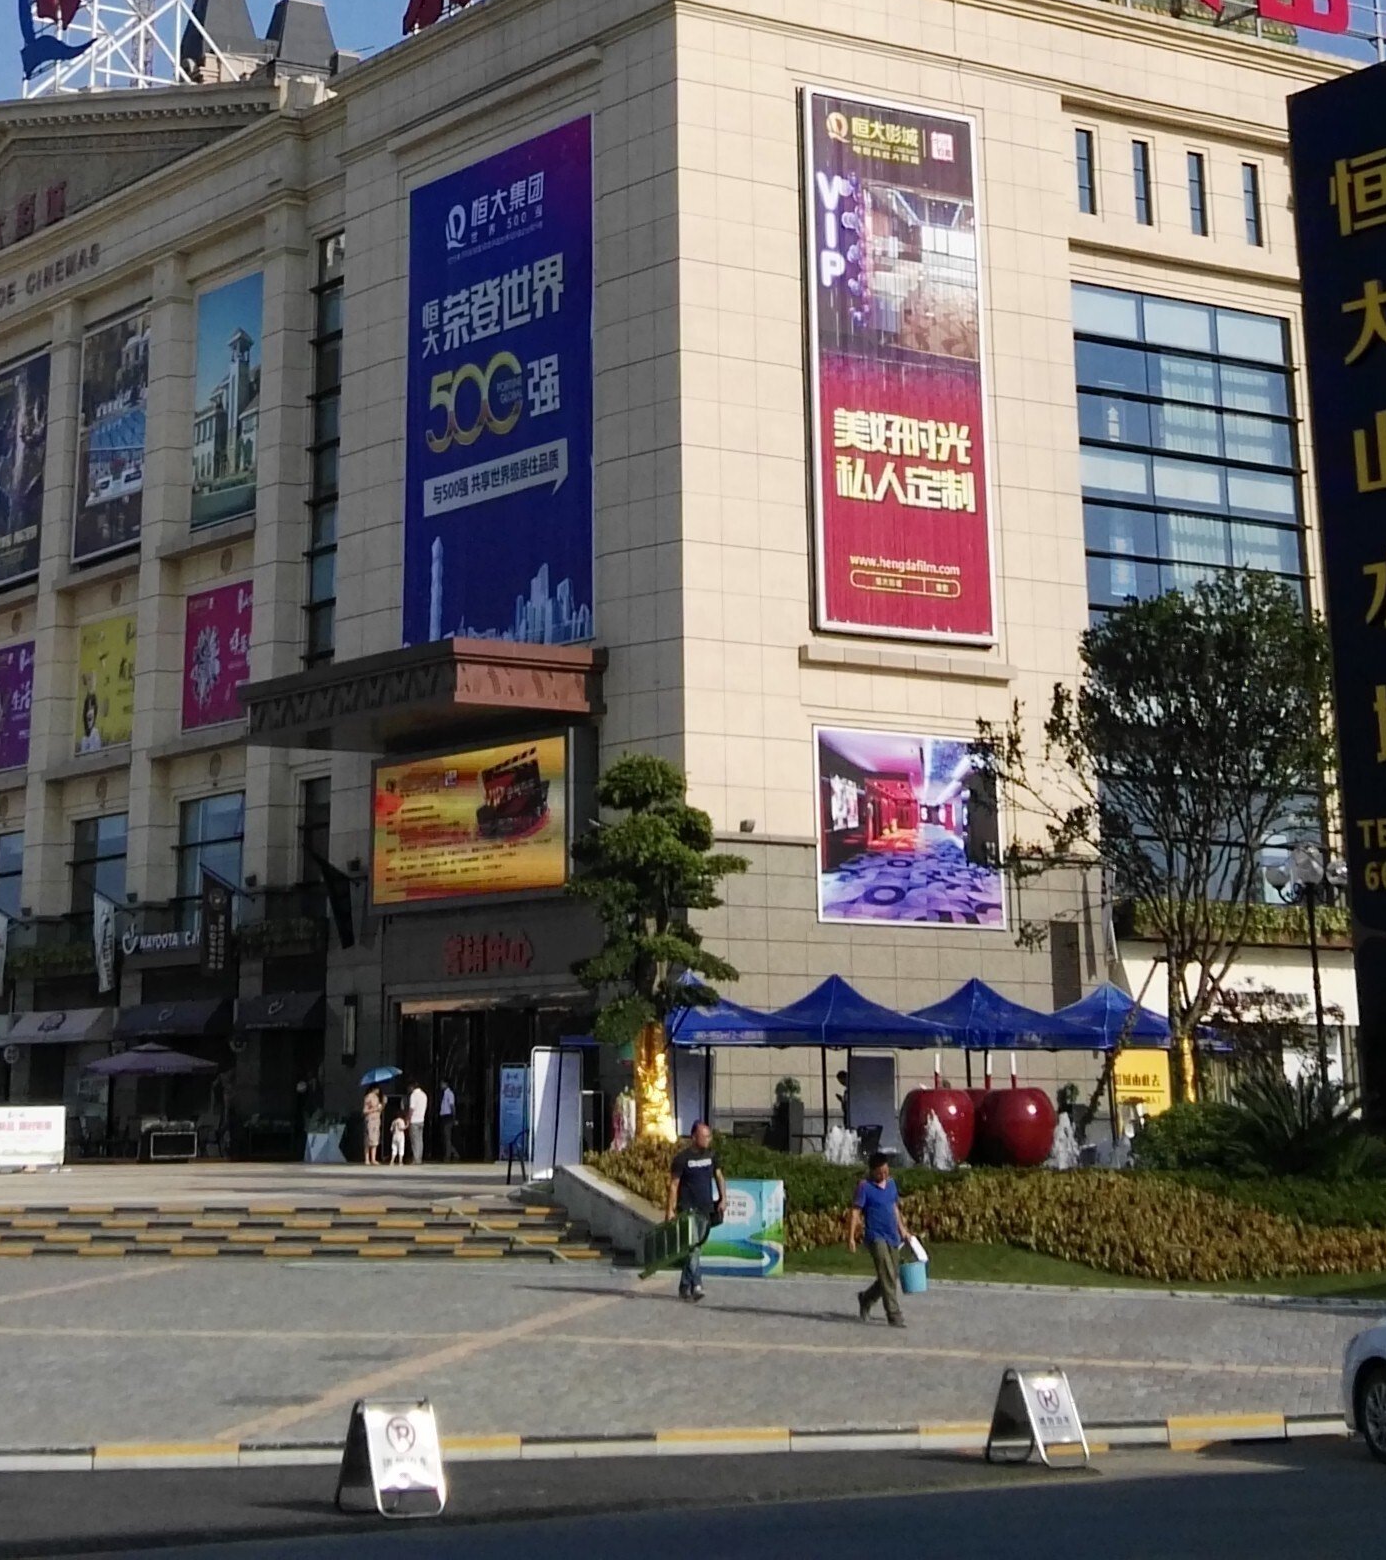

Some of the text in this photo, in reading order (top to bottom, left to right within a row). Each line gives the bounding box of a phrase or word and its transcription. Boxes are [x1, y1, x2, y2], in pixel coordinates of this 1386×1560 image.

[851, 117, 919, 148] 恒大影城
[471, 171, 544, 227] 恒大集团
[816, 171, 846, 287] VIP
[25, 242, 101, 296] CINEMAS
[422, 298, 439, 359] 恒大
[443, 252, 564, 355] 荣登世界
[526, 354, 561, 418] 强
[834, 408, 972, 465] 美好时光
[432, 453, 559, 505] 与500强 共享世界级居住品质
[836, 455, 977, 513] 私人定制
[850, 555, 961, 576] www.hengdafilm.com
